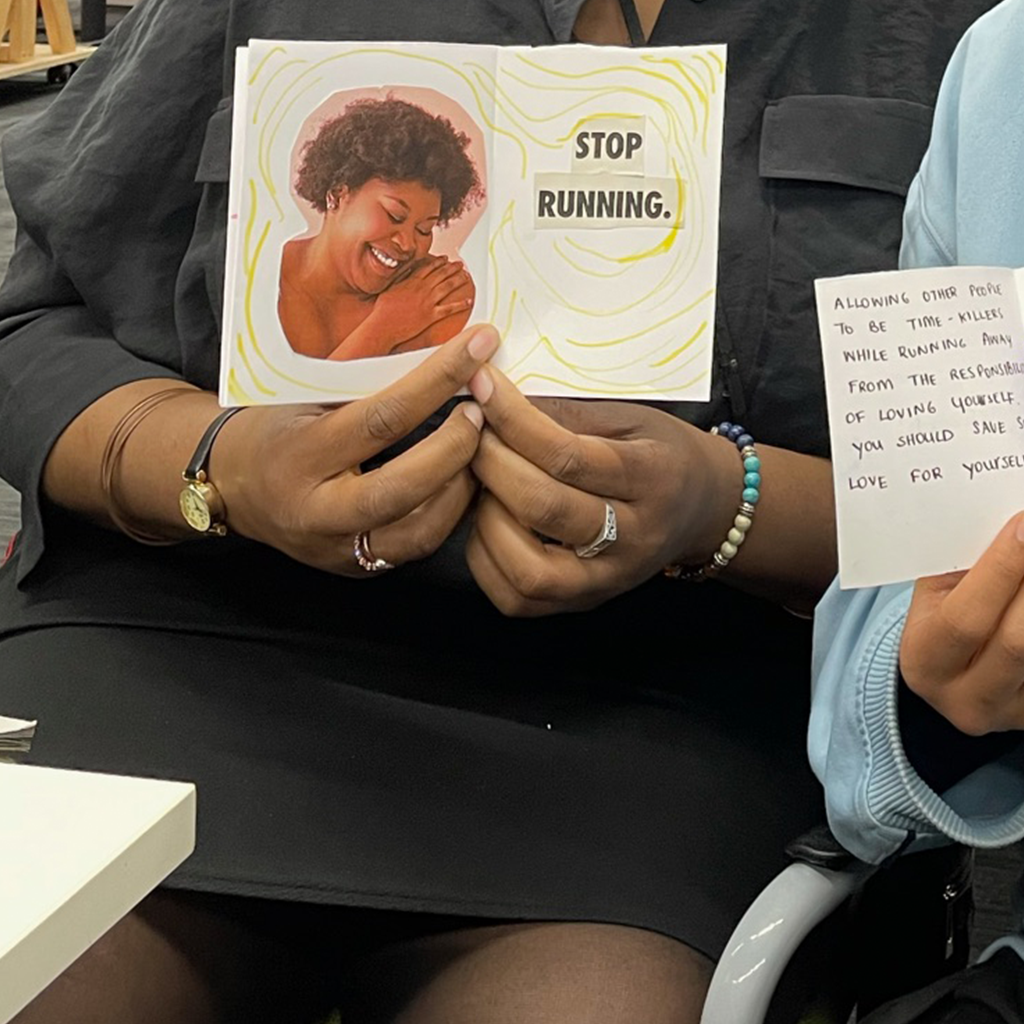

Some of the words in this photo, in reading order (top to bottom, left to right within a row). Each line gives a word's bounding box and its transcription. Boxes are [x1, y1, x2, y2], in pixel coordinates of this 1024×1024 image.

[575, 131, 643, 159] STOP
[538, 190, 671, 219] RUNNING.
[834, 291, 910, 310] ALLOWING
[922, 285, 957, 302] OTHER
[969, 281, 1002, 297] PEOPLE
[834, 322, 853, 335] TO
[869, 320, 887, 333] BE
[843, 350, 888, 362] WHILE
[898, 339, 967, 359] RUNNING
[982, 331, 1013, 348] AWAY
[849, 379, 894, 394] FROM
[908, 374, 936, 387] THE
[845, 412, 865, 424] OF
[878, 401, 936, 421] LOVING
[896, 429, 954, 448] SHOULD
[973, 420, 1006, 436] SAVE
[849, 477, 888, 490] LOVE
[911, 467, 942, 483] FOR
